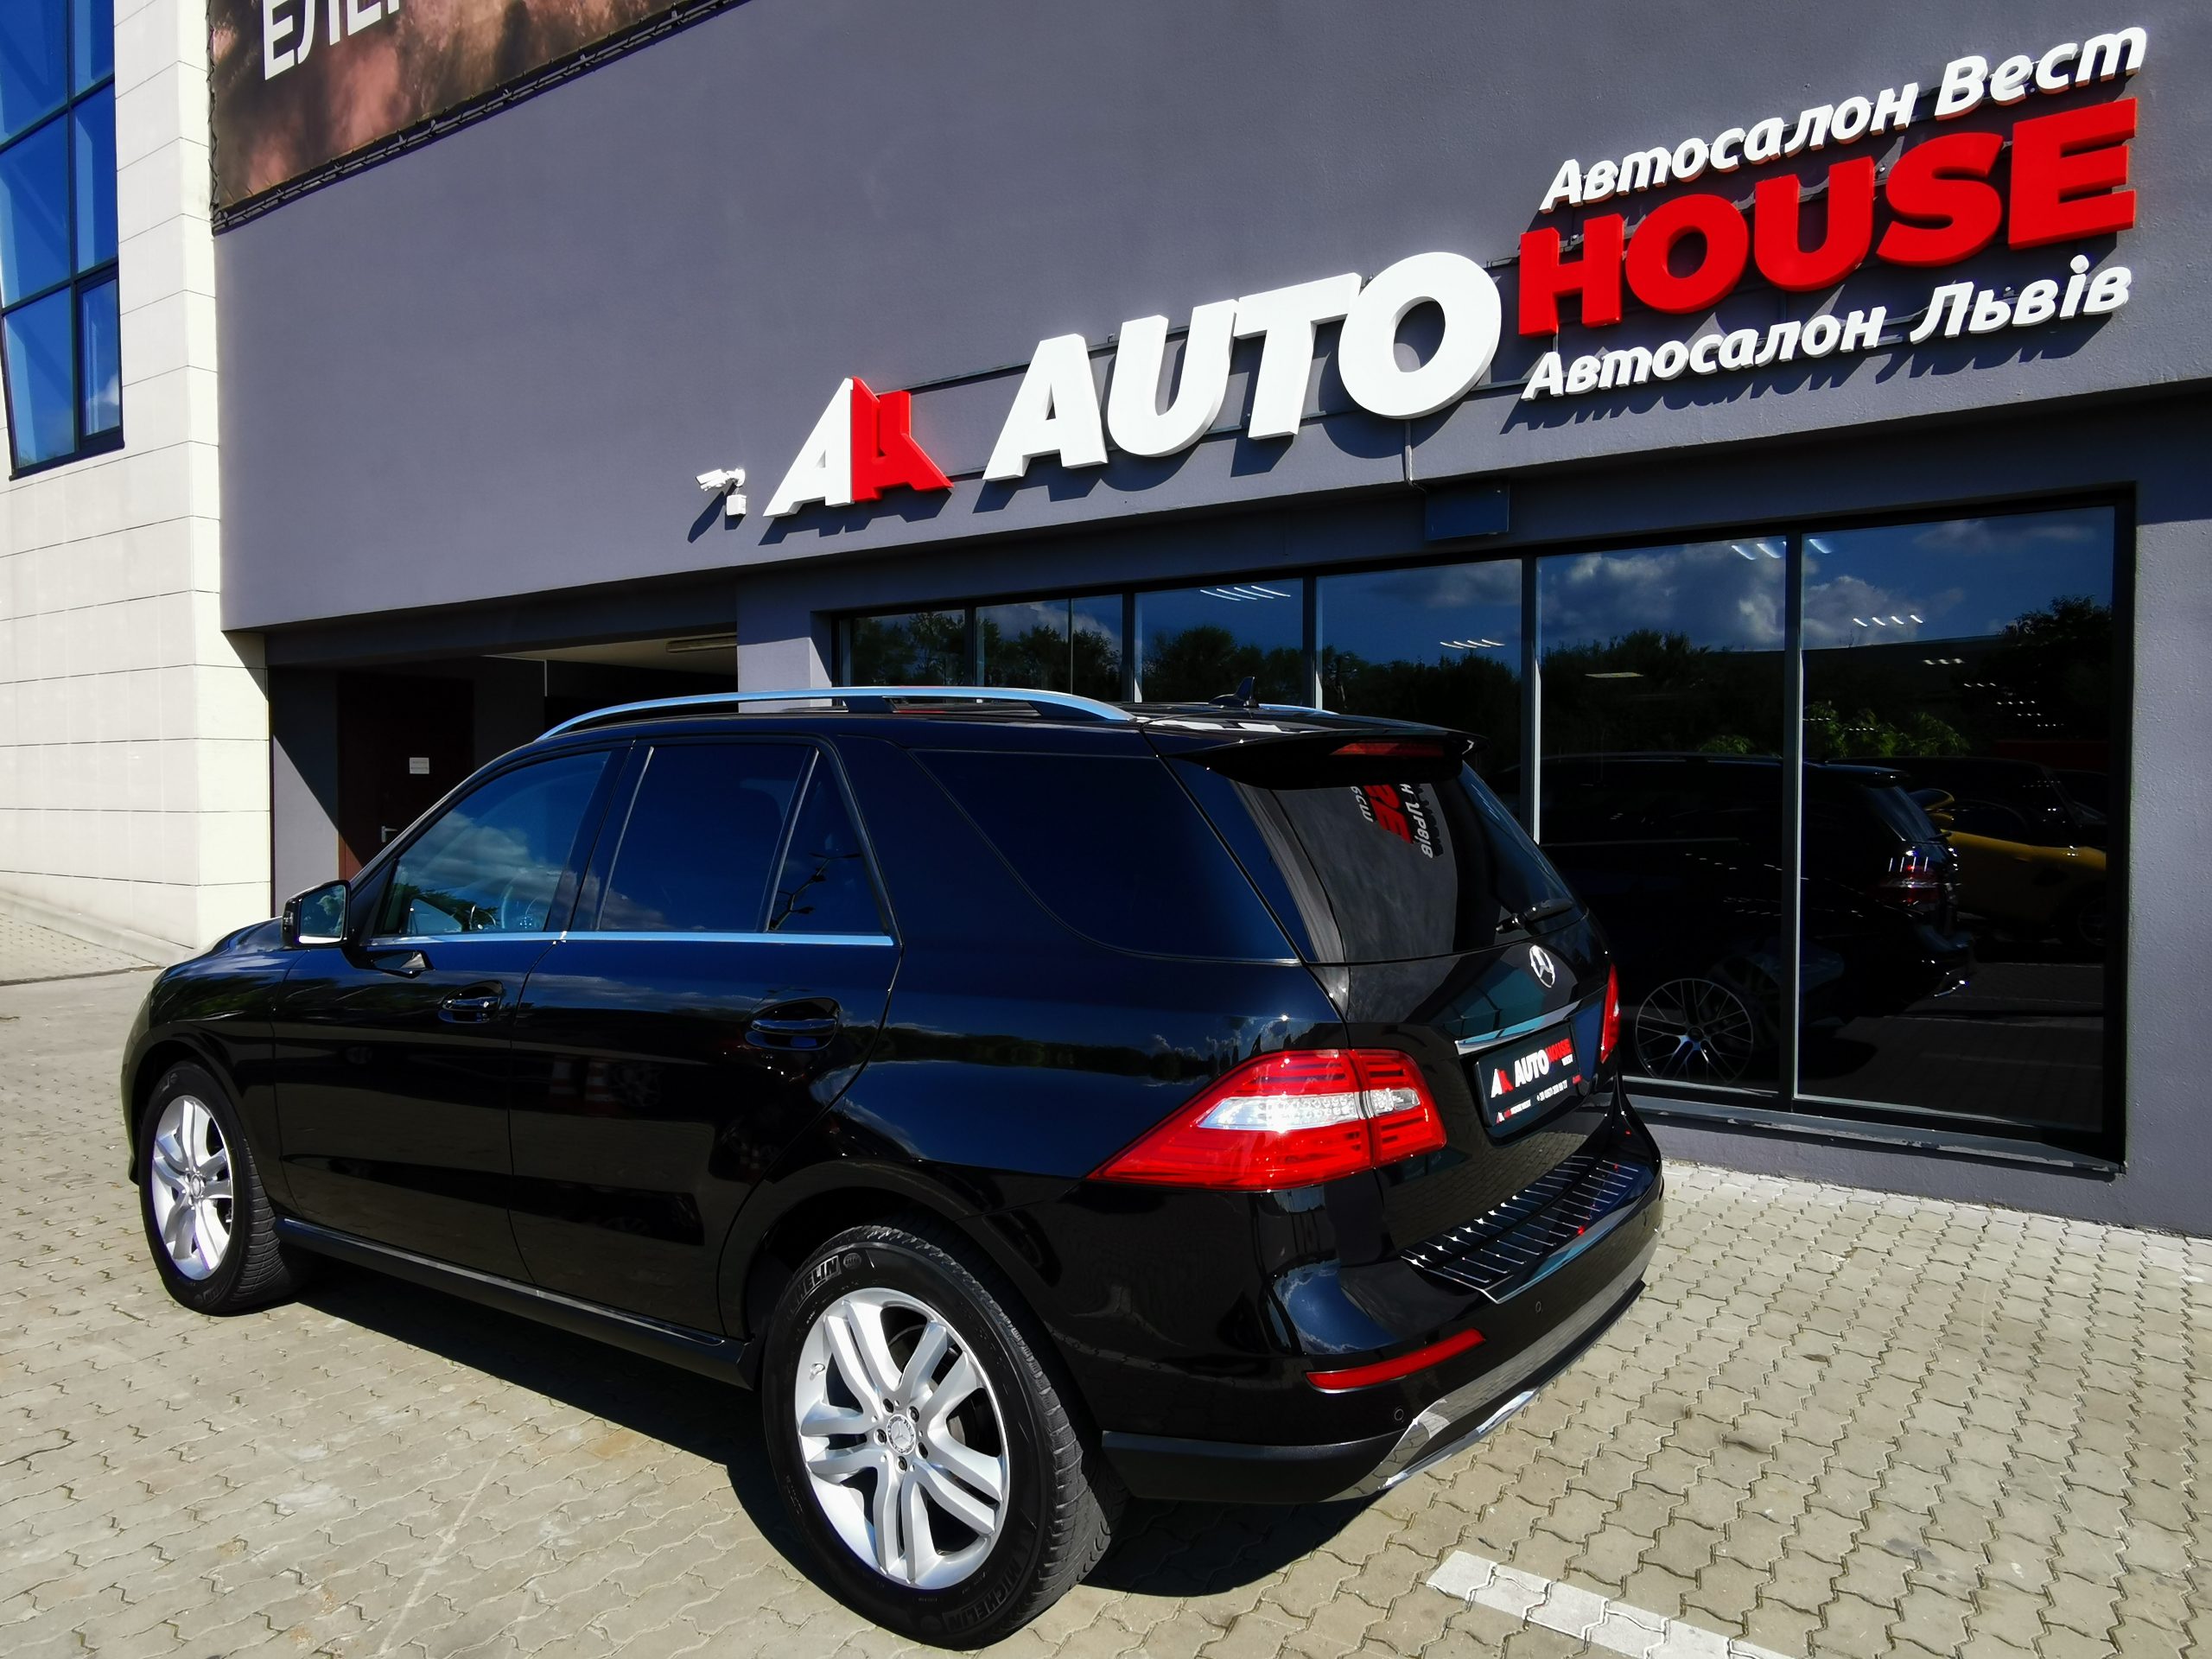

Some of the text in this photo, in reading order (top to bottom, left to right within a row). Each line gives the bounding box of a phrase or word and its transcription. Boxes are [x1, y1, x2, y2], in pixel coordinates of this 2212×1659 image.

[263, 0, 399, 81] ЕЛ
[1538, 27, 2148, 213] Автосалон Вест
[982, 251, 1503, 483] AUTO
[1518, 98, 2137, 338] HOUSE
[1521, 254, 2133, 402] Автосалон Львів
[1514, 1049, 1549, 1088] AUTO
